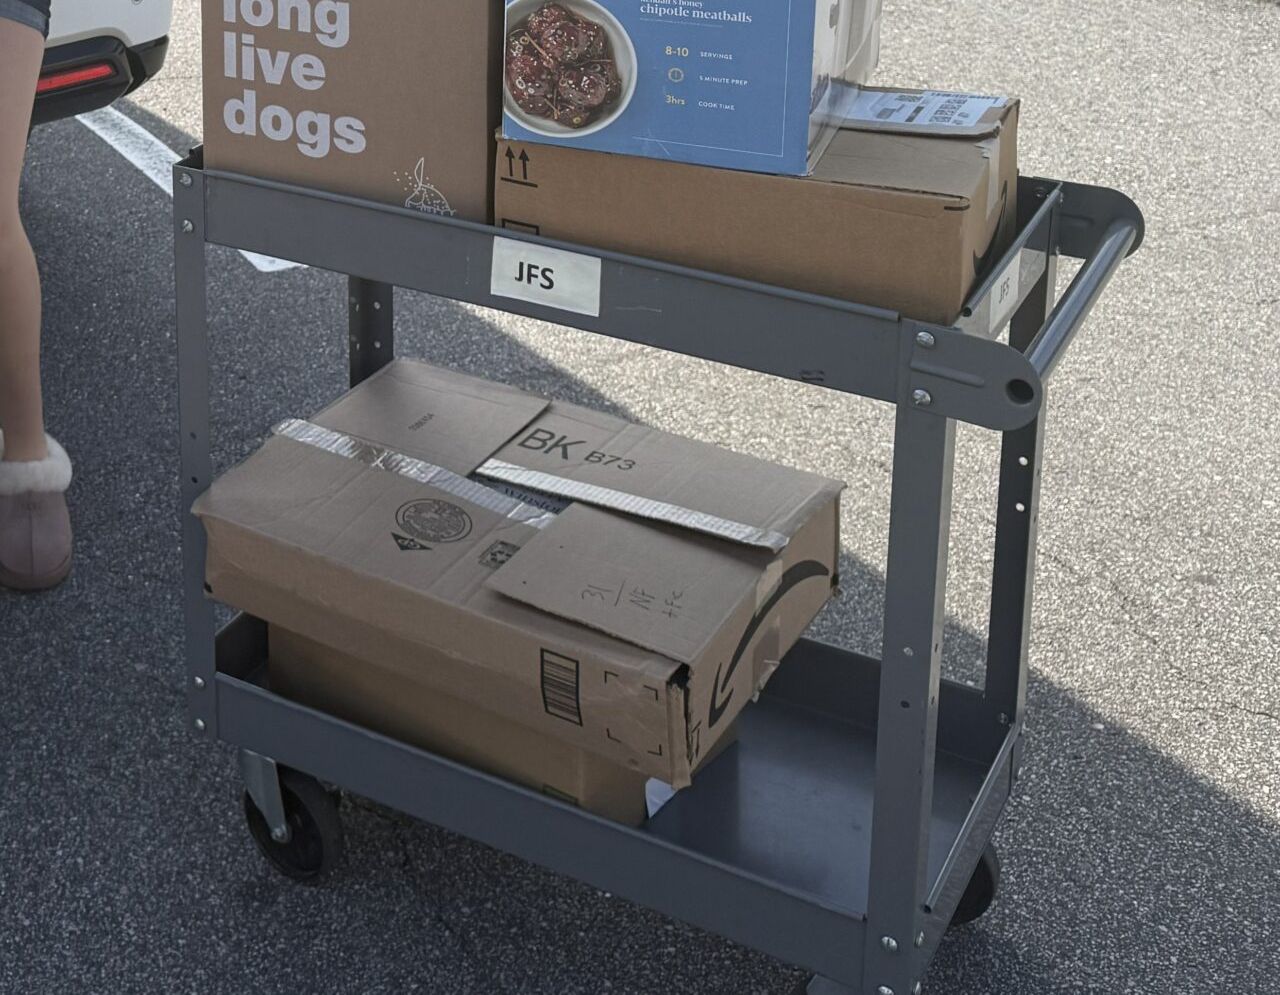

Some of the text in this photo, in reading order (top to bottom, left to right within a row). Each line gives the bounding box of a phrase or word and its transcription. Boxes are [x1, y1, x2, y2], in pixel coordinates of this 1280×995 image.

[640, 4, 690, 17] chipotle
[692, 10, 753, 23] meatballs
[223, 31, 326, 91] live
[665, 45, 733, 60] 8-10 SERVINGS
[704, 76, 729, 84] MINUTE
[731, 78, 748, 86] PREP
[666, 94, 685, 105] 3hrs
[719, 103, 735, 111] TIME
[223, 88, 367, 158] dogs
[514, 261, 555, 290] JFS
[518, 427, 636, 471] BK B73
